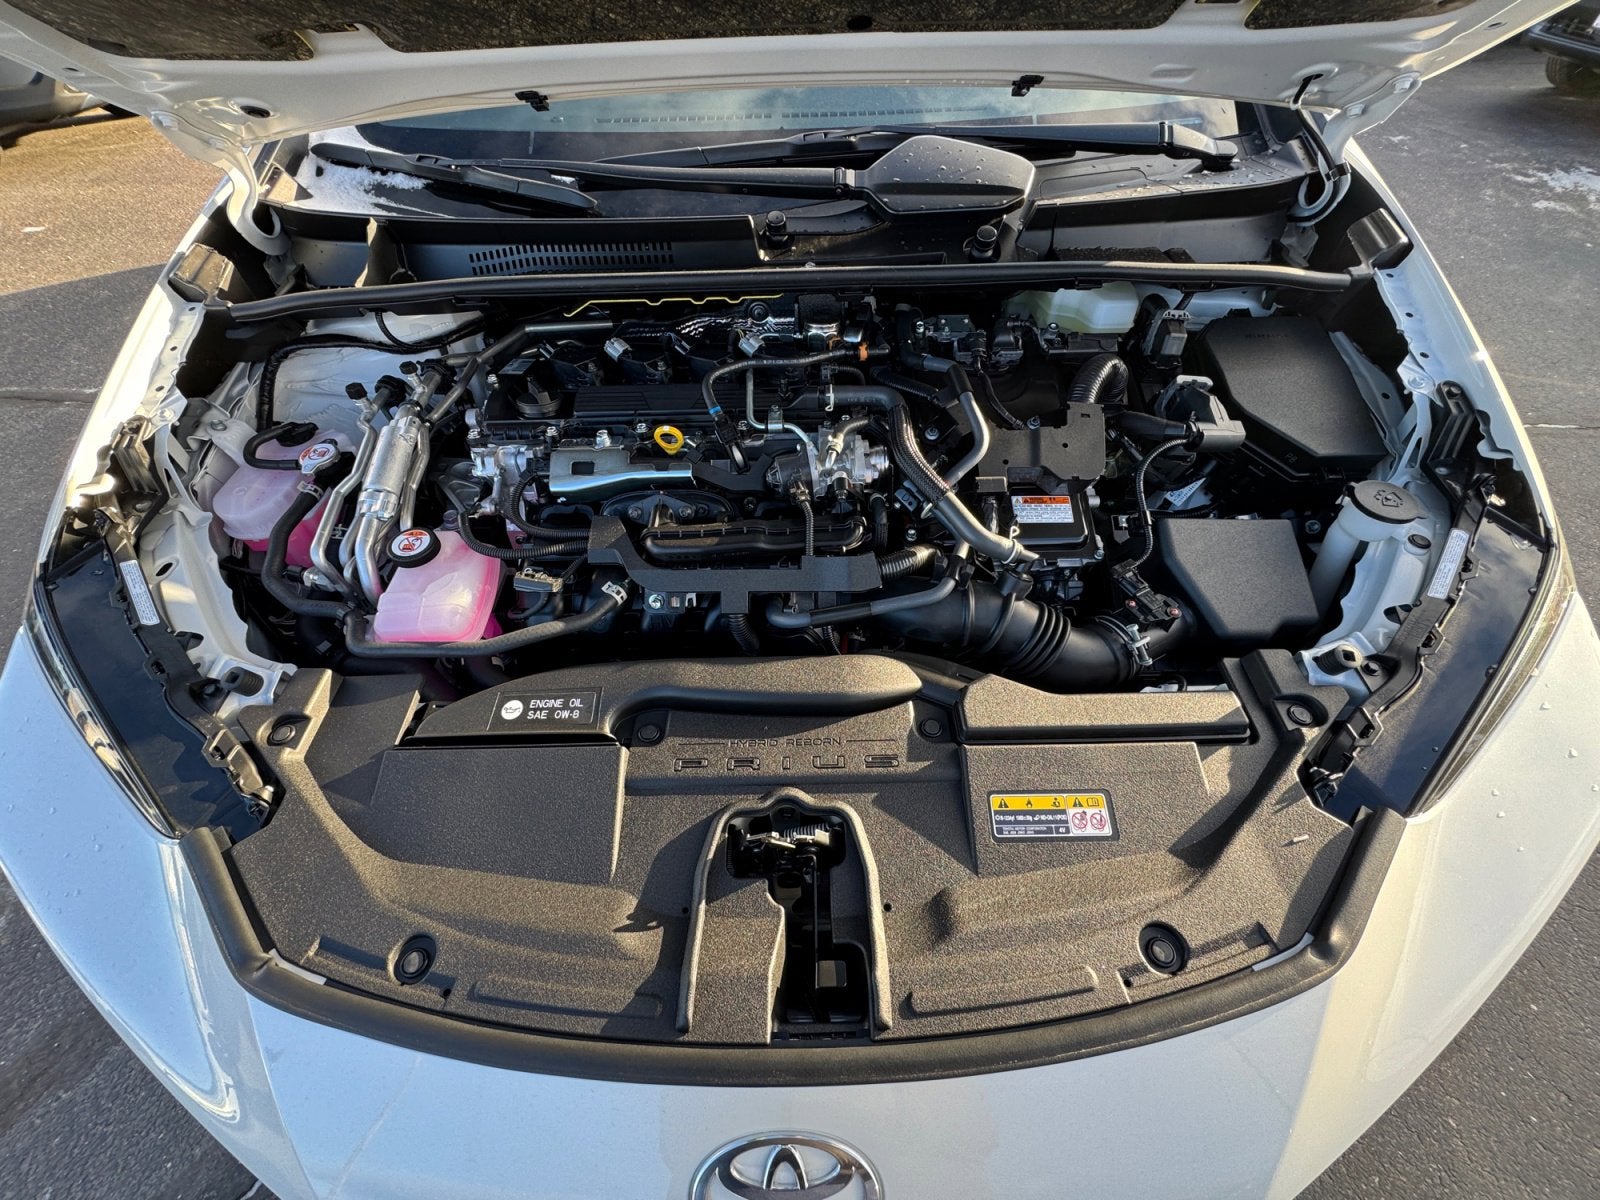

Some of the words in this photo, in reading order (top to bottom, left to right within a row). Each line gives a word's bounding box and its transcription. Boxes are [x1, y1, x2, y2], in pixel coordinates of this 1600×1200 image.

[529, 698, 564, 708] ENGINE
[569, 698, 584, 708] OIL
[526, 710, 549, 720] SAE
[728, 738, 779, 748] HYBRID
[785, 737, 842, 747] REBORN
[673, 754, 900, 772] PRIUS
